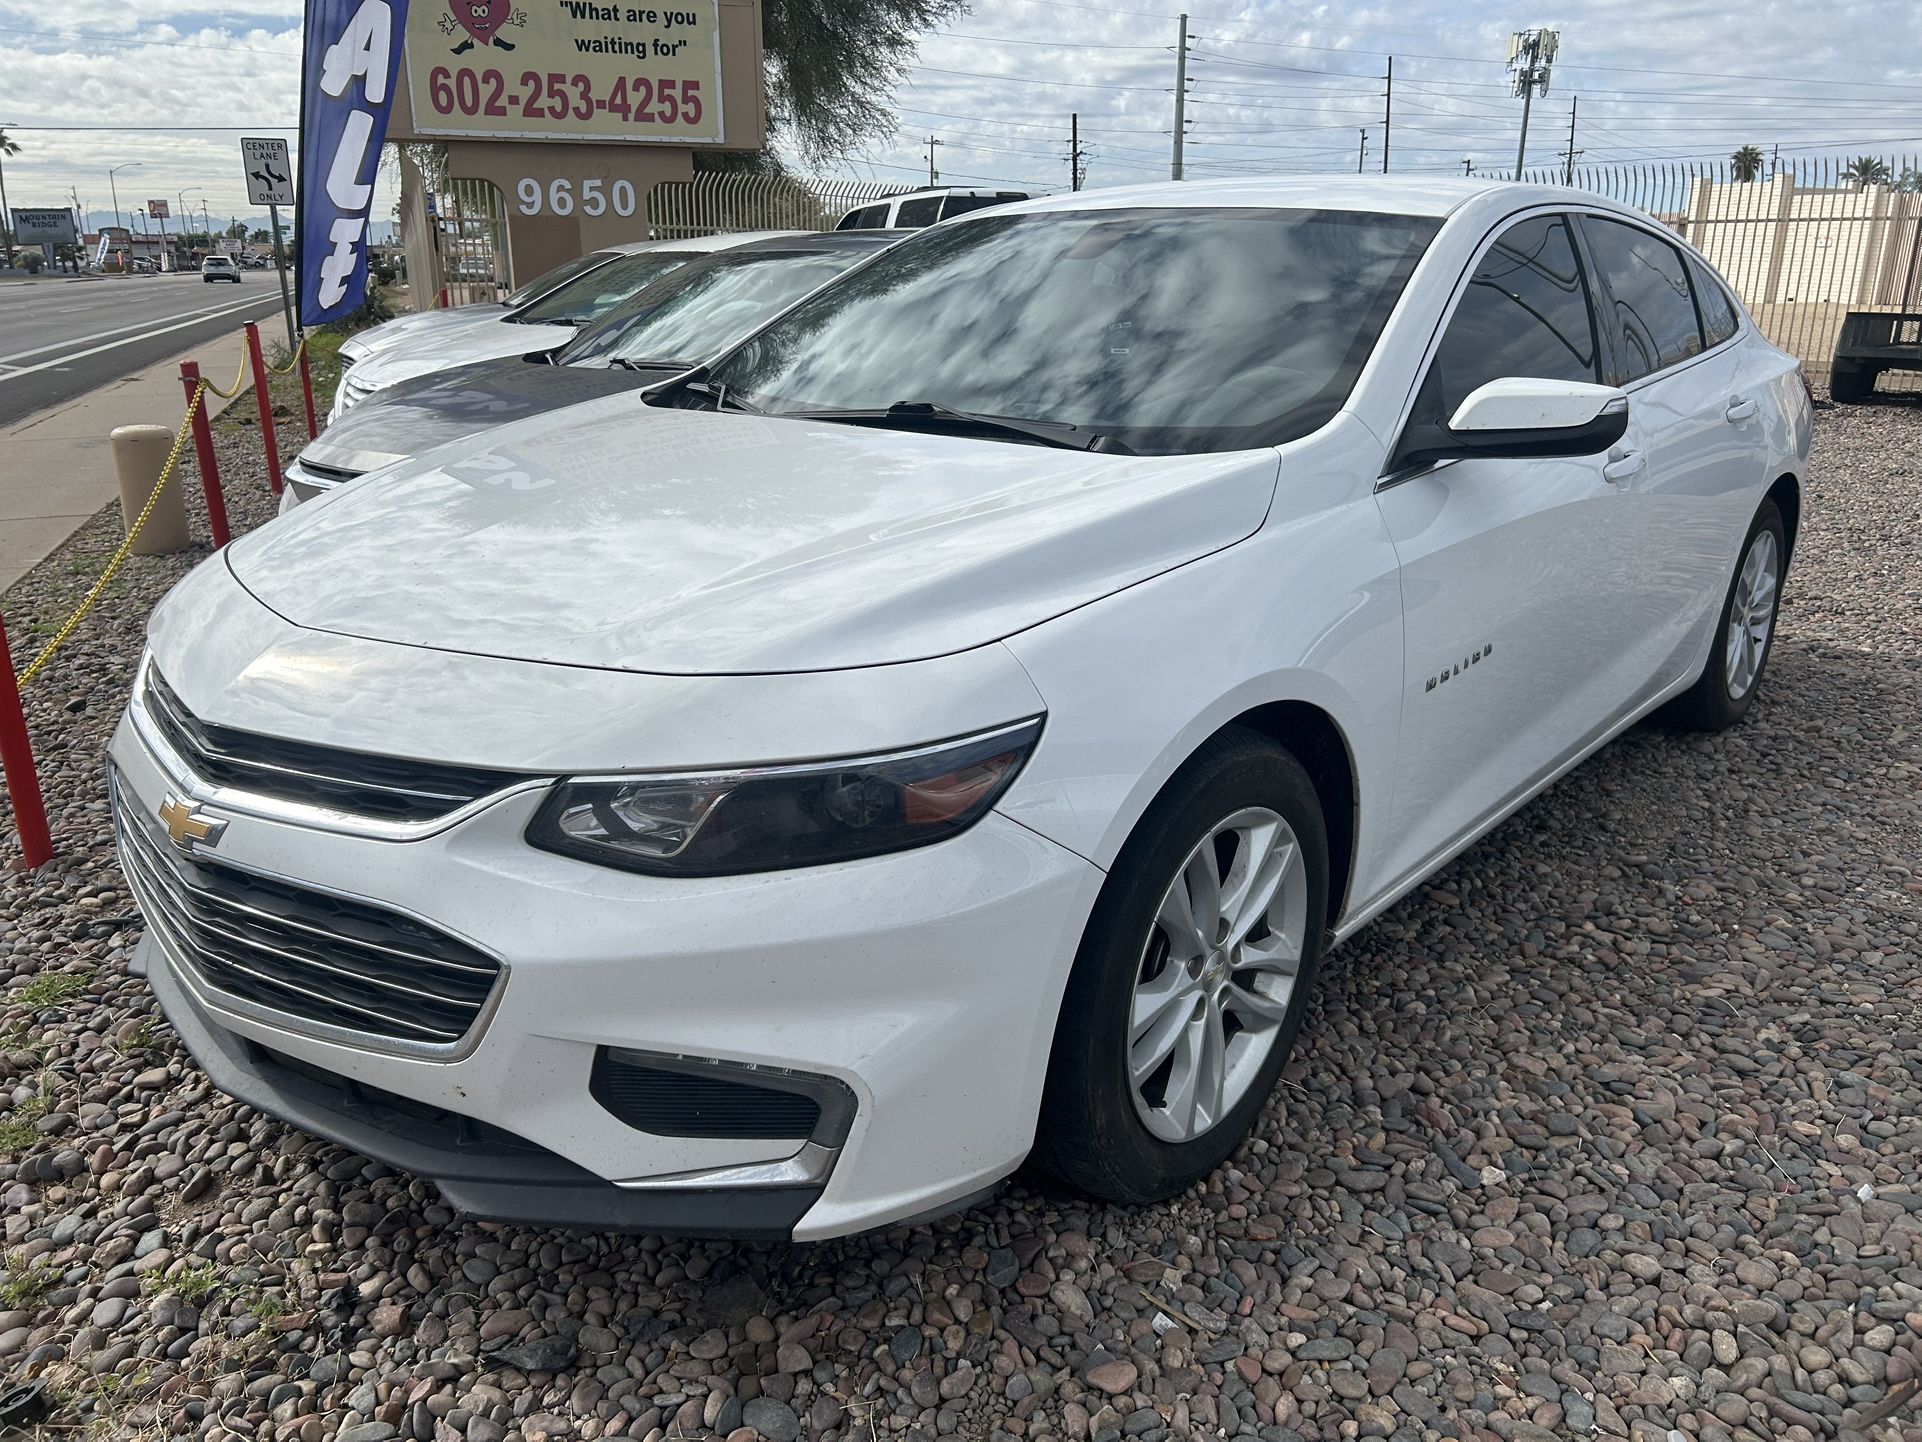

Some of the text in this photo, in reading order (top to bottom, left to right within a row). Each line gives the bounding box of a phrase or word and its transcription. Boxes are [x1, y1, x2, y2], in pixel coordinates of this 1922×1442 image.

[559, 0, 697, 29] "What are you
[574, 36, 688, 60] waiting for"
[429, 66, 703, 125] 602-253-4255
[245, 141, 284, 152] CENTER
[252, 151, 279, 161] LANE
[258, 192, 285, 202] ONLY
[516, 177, 636, 217] 9650
[31, 220, 60, 229] RIDGE
